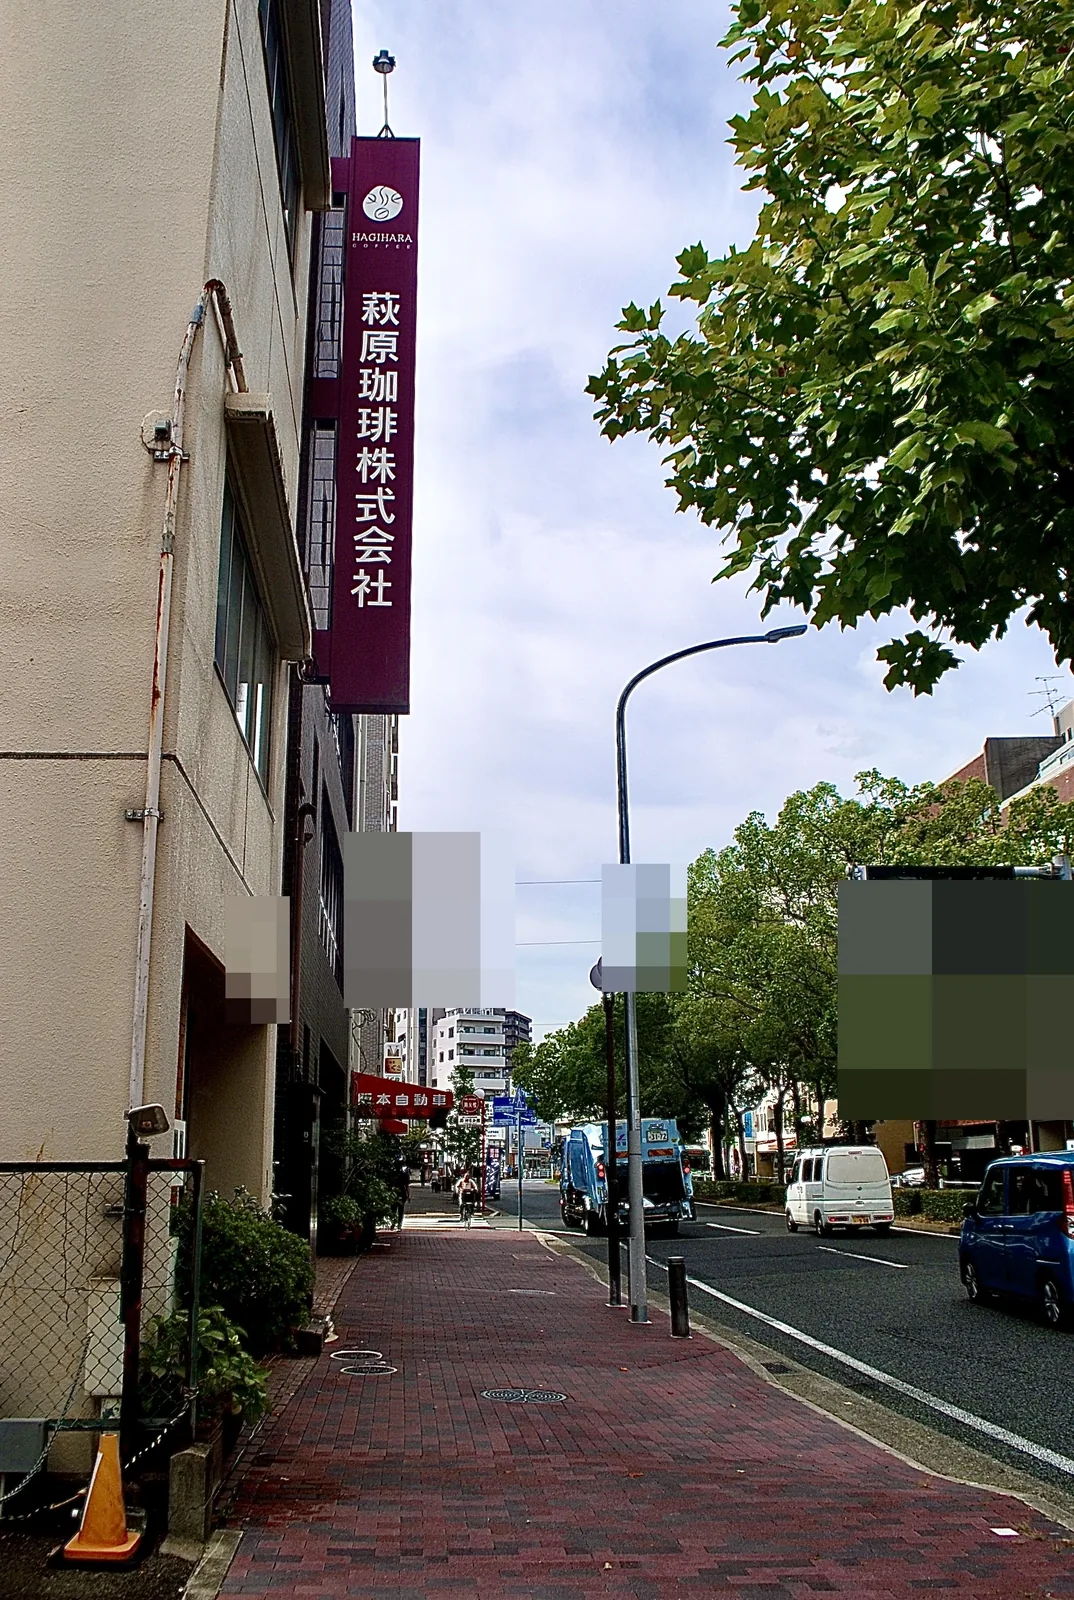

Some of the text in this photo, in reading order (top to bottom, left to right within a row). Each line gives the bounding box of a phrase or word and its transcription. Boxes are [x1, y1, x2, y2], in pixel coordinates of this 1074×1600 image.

[352, 232, 413, 243] HAGIHARA
[351, 291, 400, 608] 萩原珈琲株式会社
